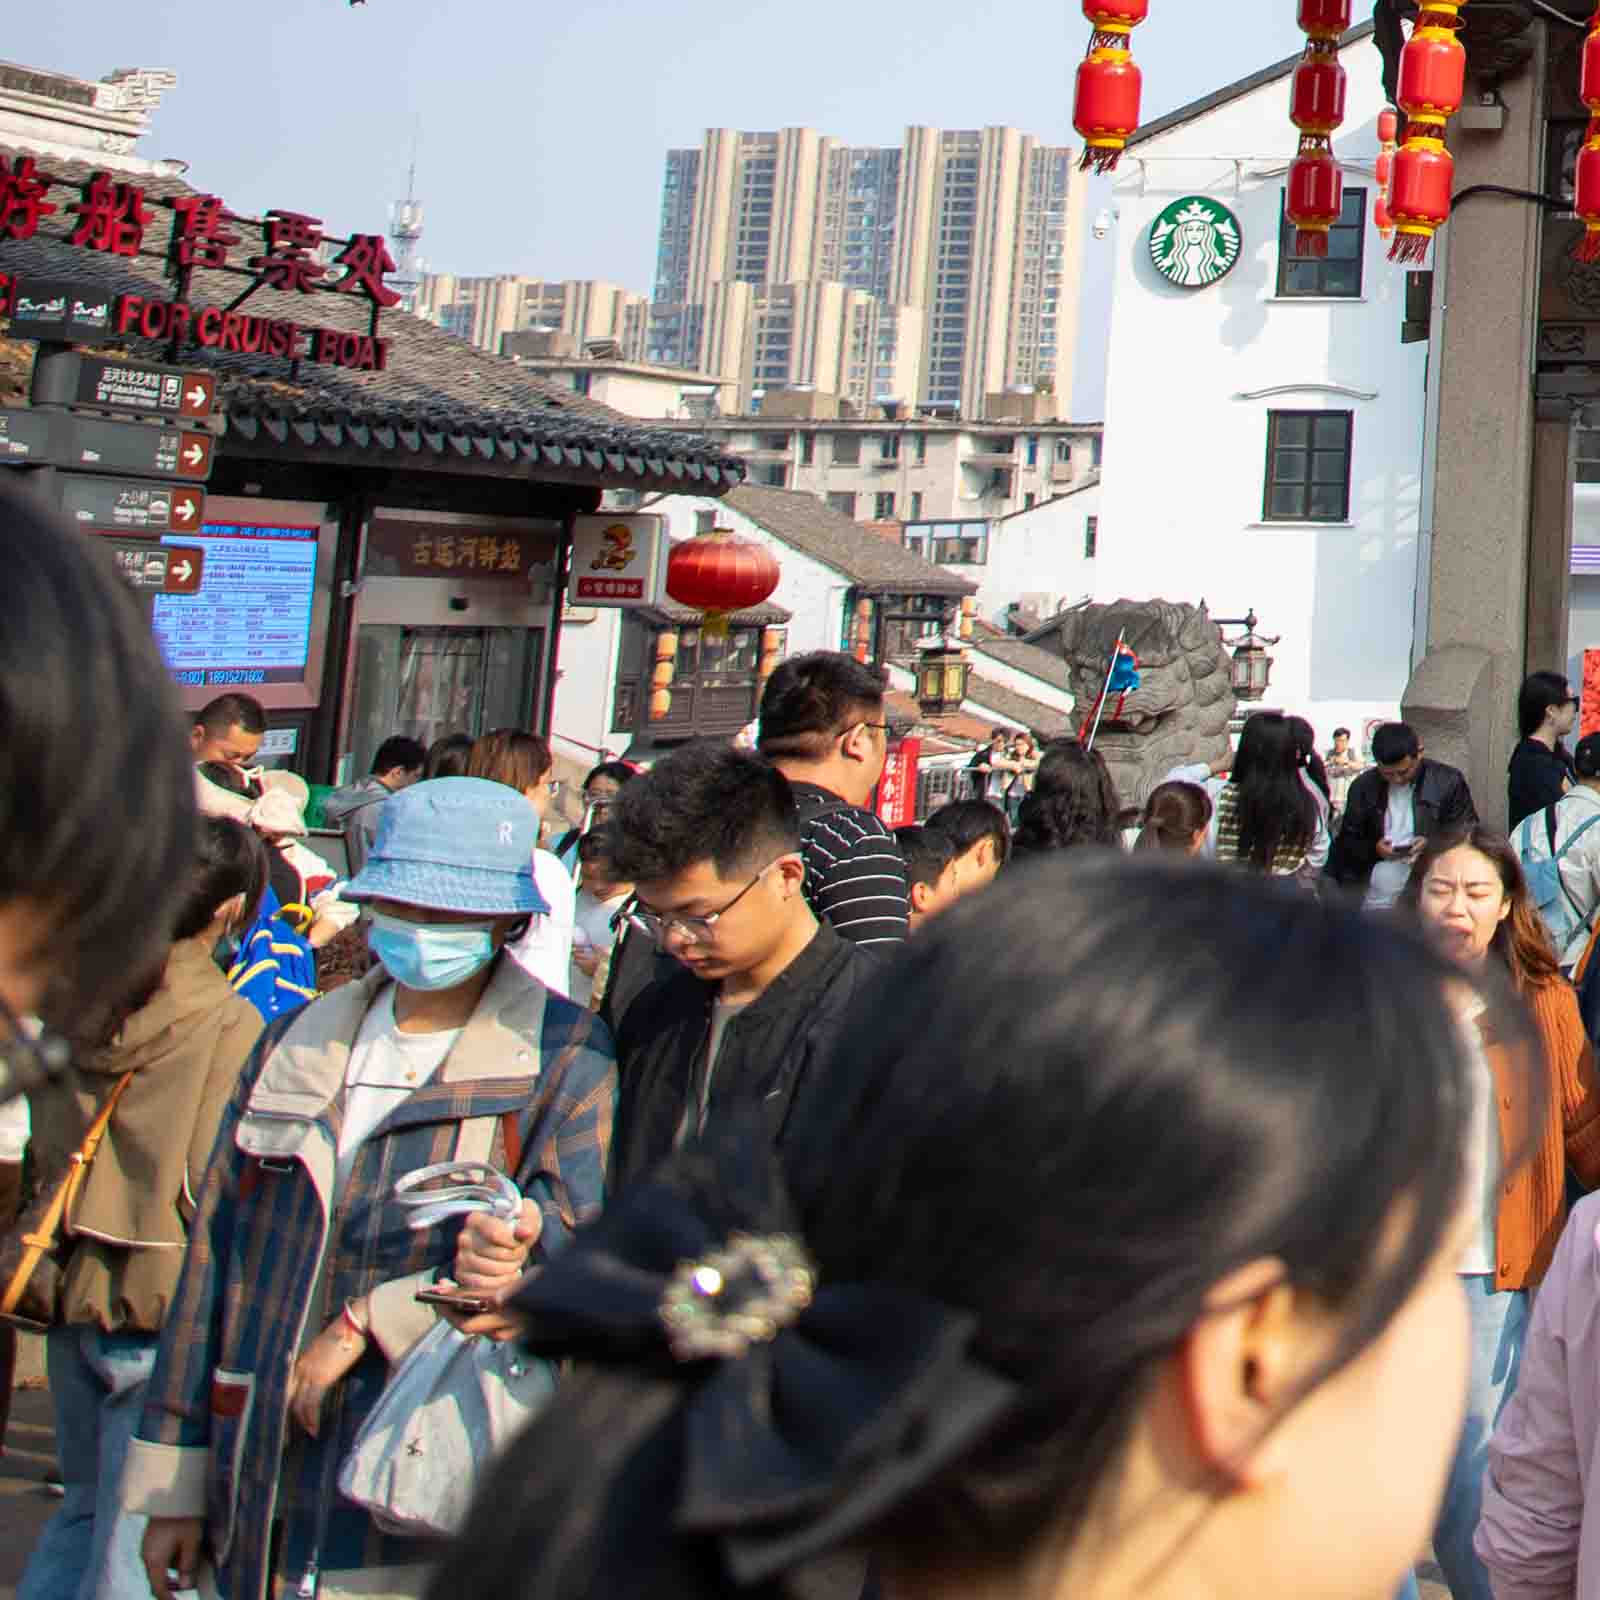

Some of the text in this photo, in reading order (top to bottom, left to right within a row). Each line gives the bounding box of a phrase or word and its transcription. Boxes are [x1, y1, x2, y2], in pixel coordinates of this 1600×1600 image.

[117, 294, 190, 342] FOR
[199, 305, 311, 362] CRUISE
[316, 328, 393, 371] BOAT
